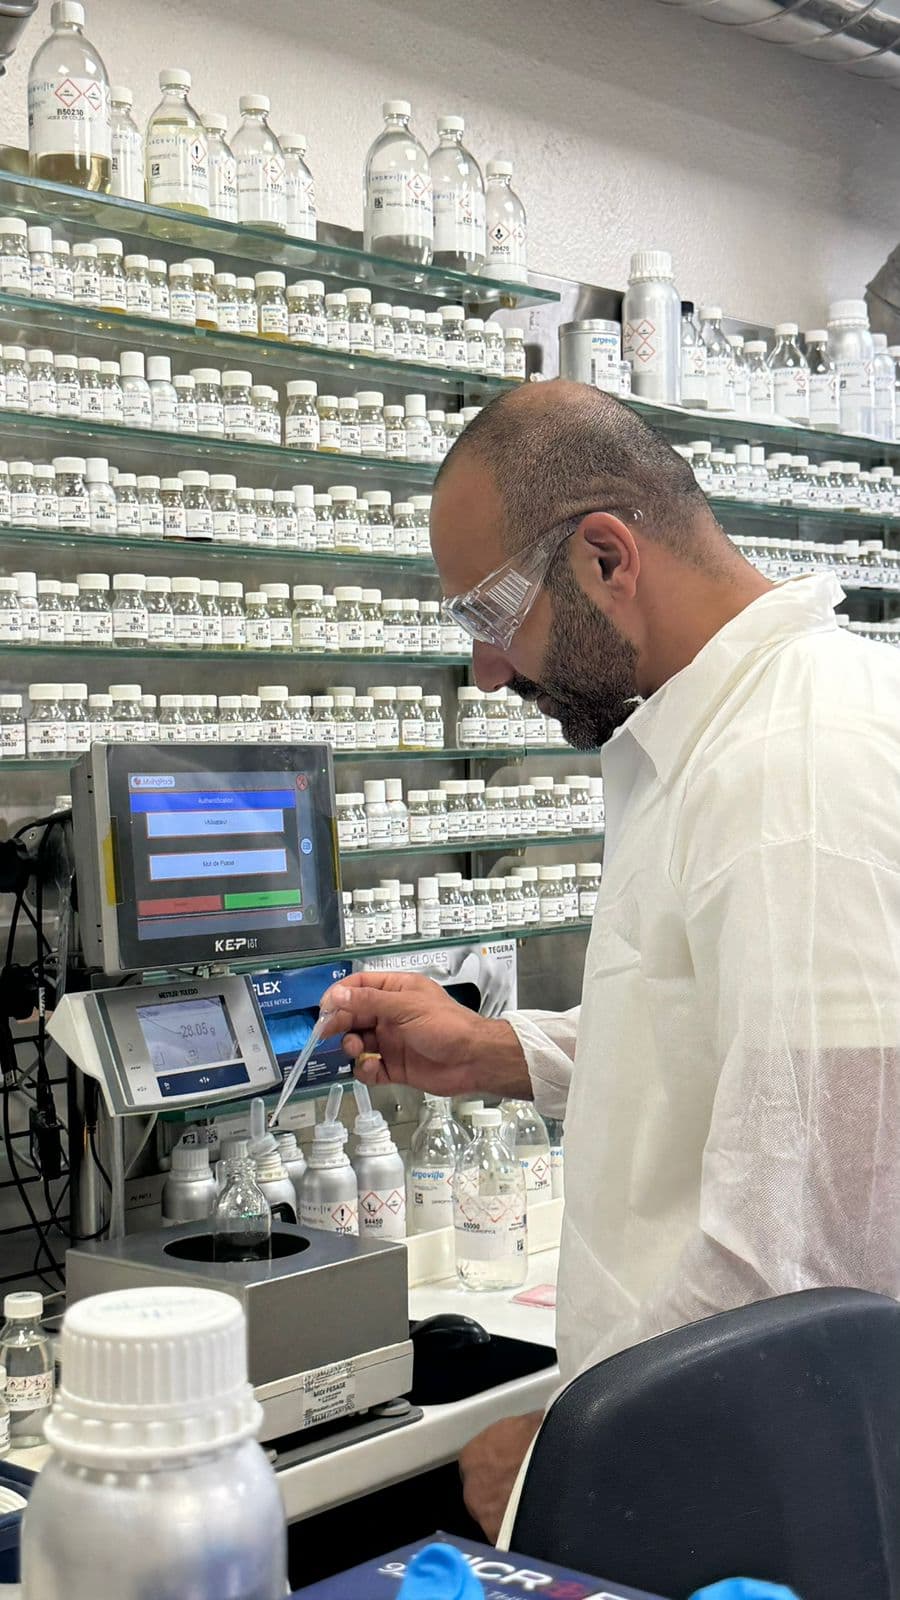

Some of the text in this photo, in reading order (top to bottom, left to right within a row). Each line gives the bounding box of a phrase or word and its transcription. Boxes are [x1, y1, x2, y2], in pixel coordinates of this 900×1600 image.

[488, 944, 514, 954] TEGERA
[368, 951, 448, 970] NITRILE GLOVES
